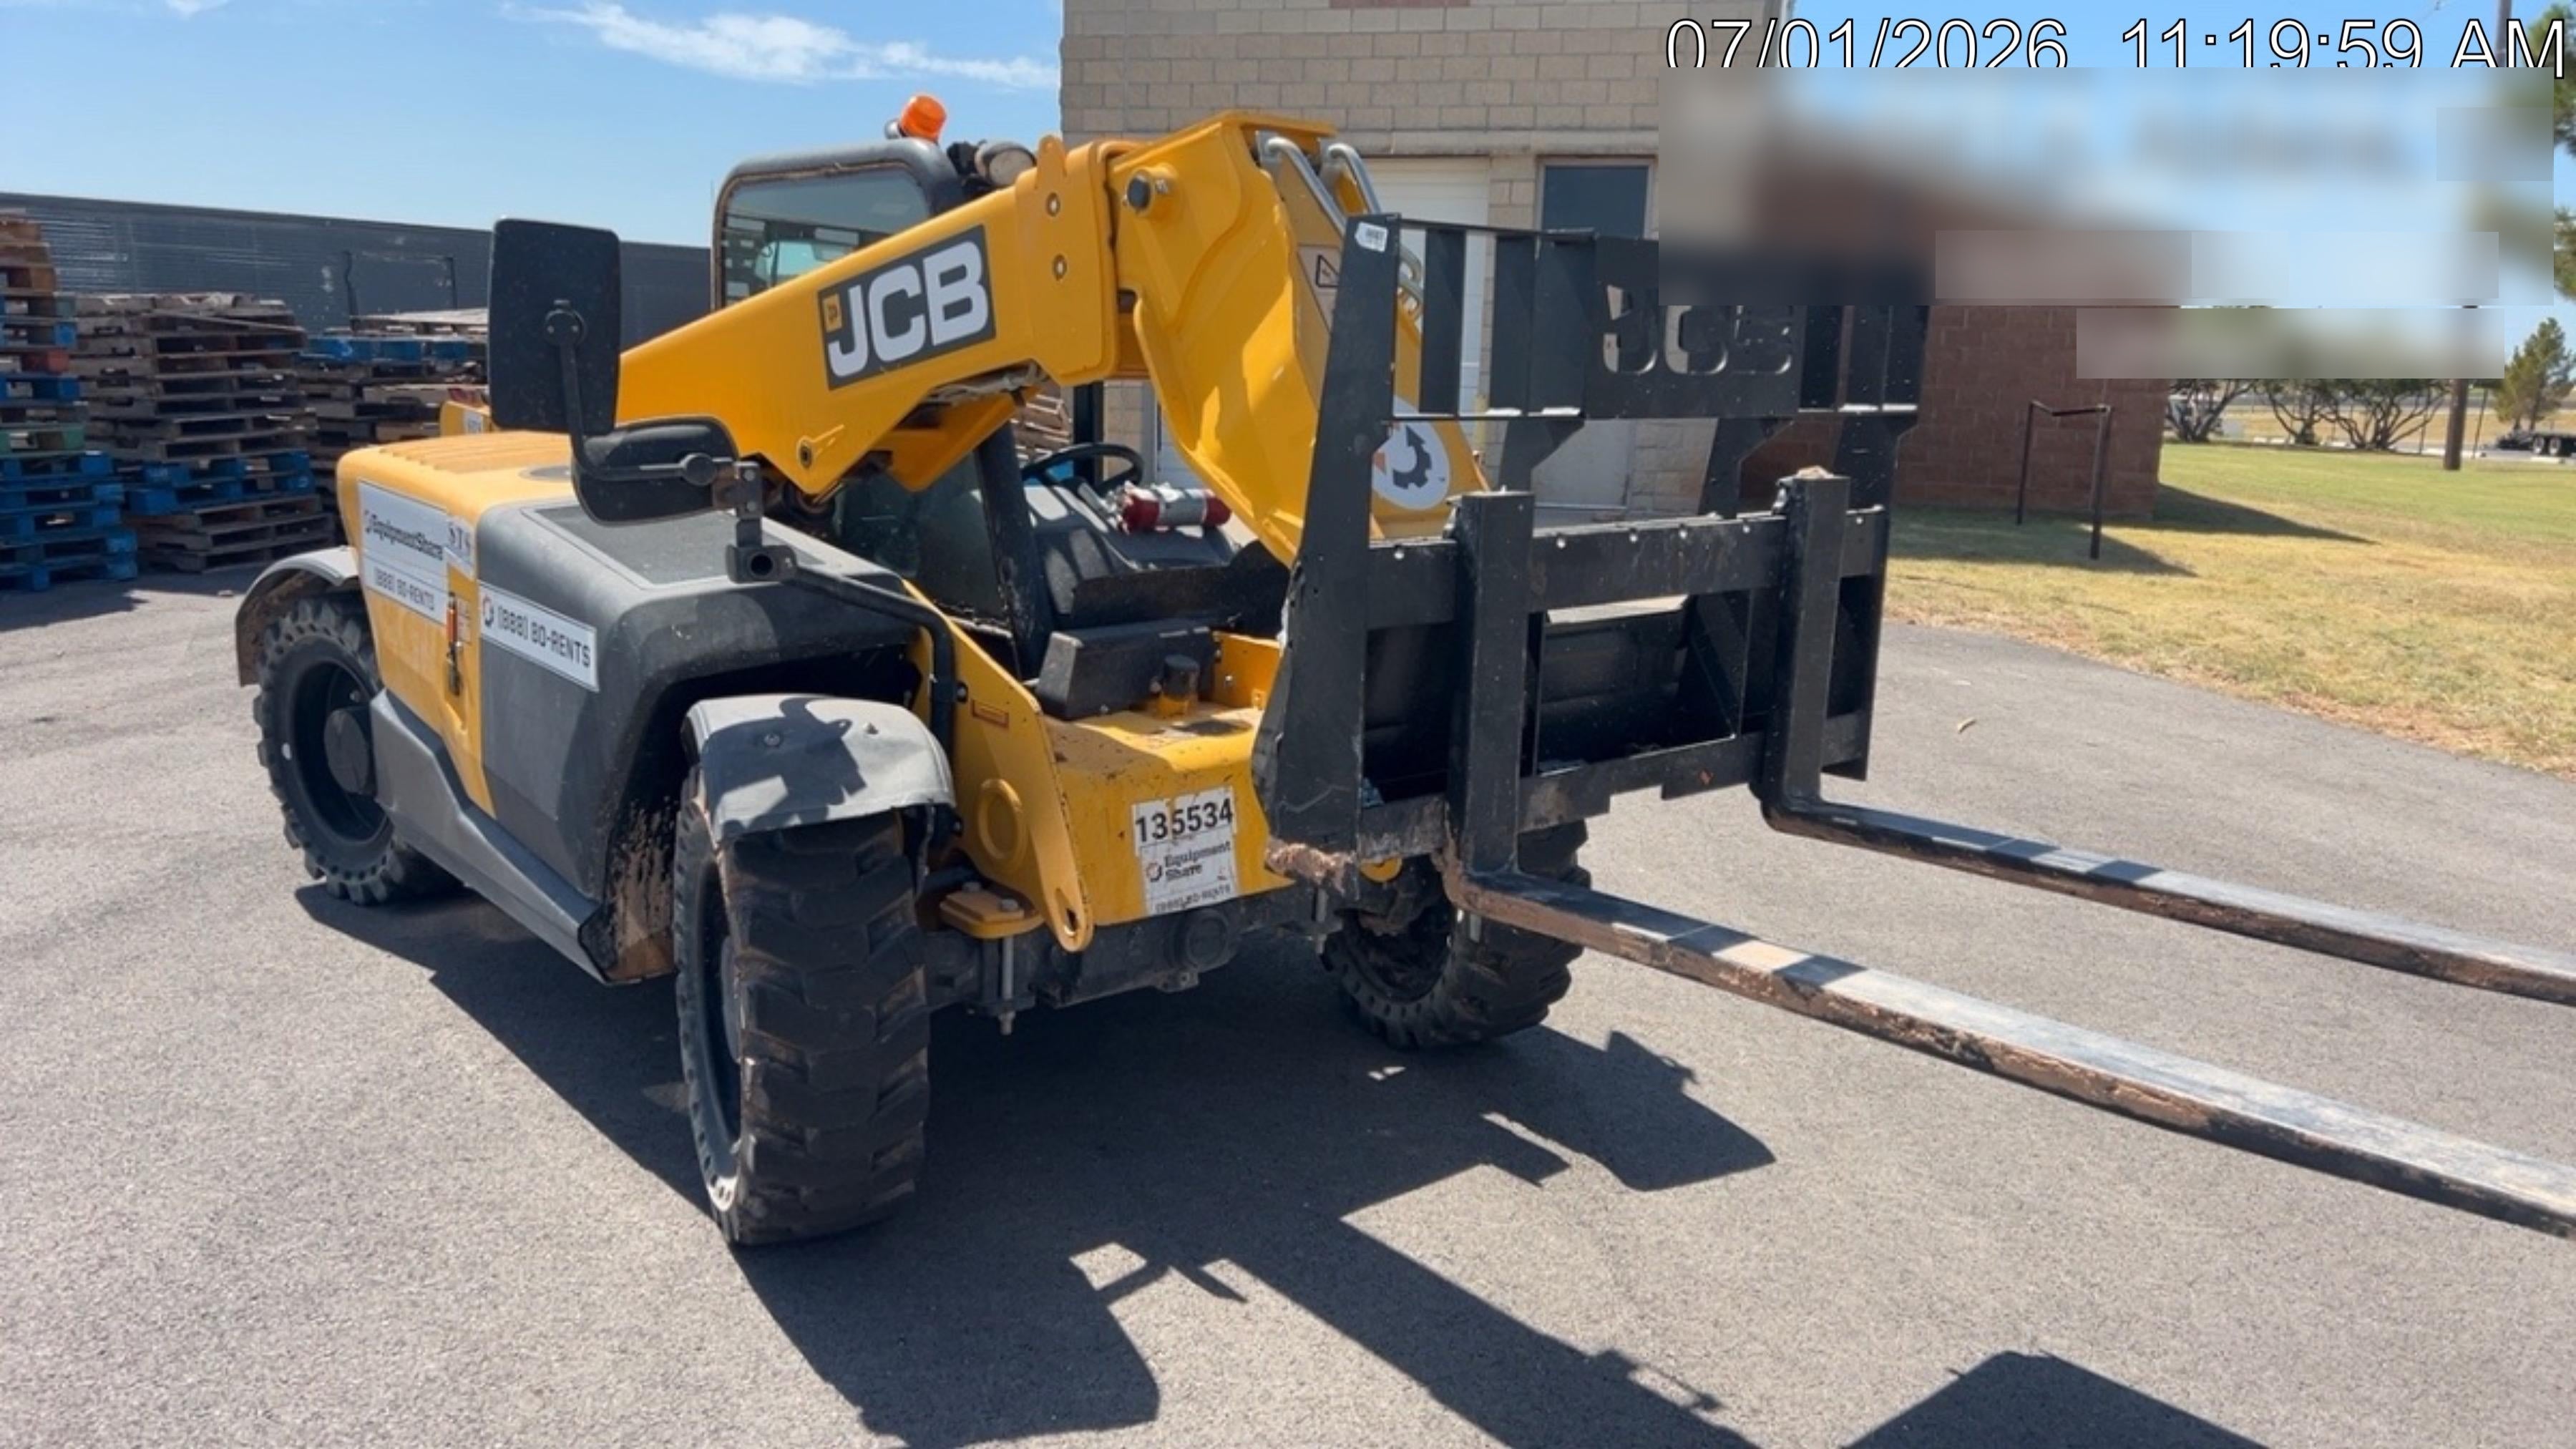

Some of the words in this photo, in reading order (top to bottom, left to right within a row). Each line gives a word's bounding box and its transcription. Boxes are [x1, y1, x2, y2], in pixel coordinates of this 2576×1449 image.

[828, 241, 989, 377] JCB
[532, 621, 591, 668] 80-RENTS
[1136, 798, 1232, 842] 135534
[1164, 840, 1231, 868] Equipment
[1165, 864, 1203, 881] Share
